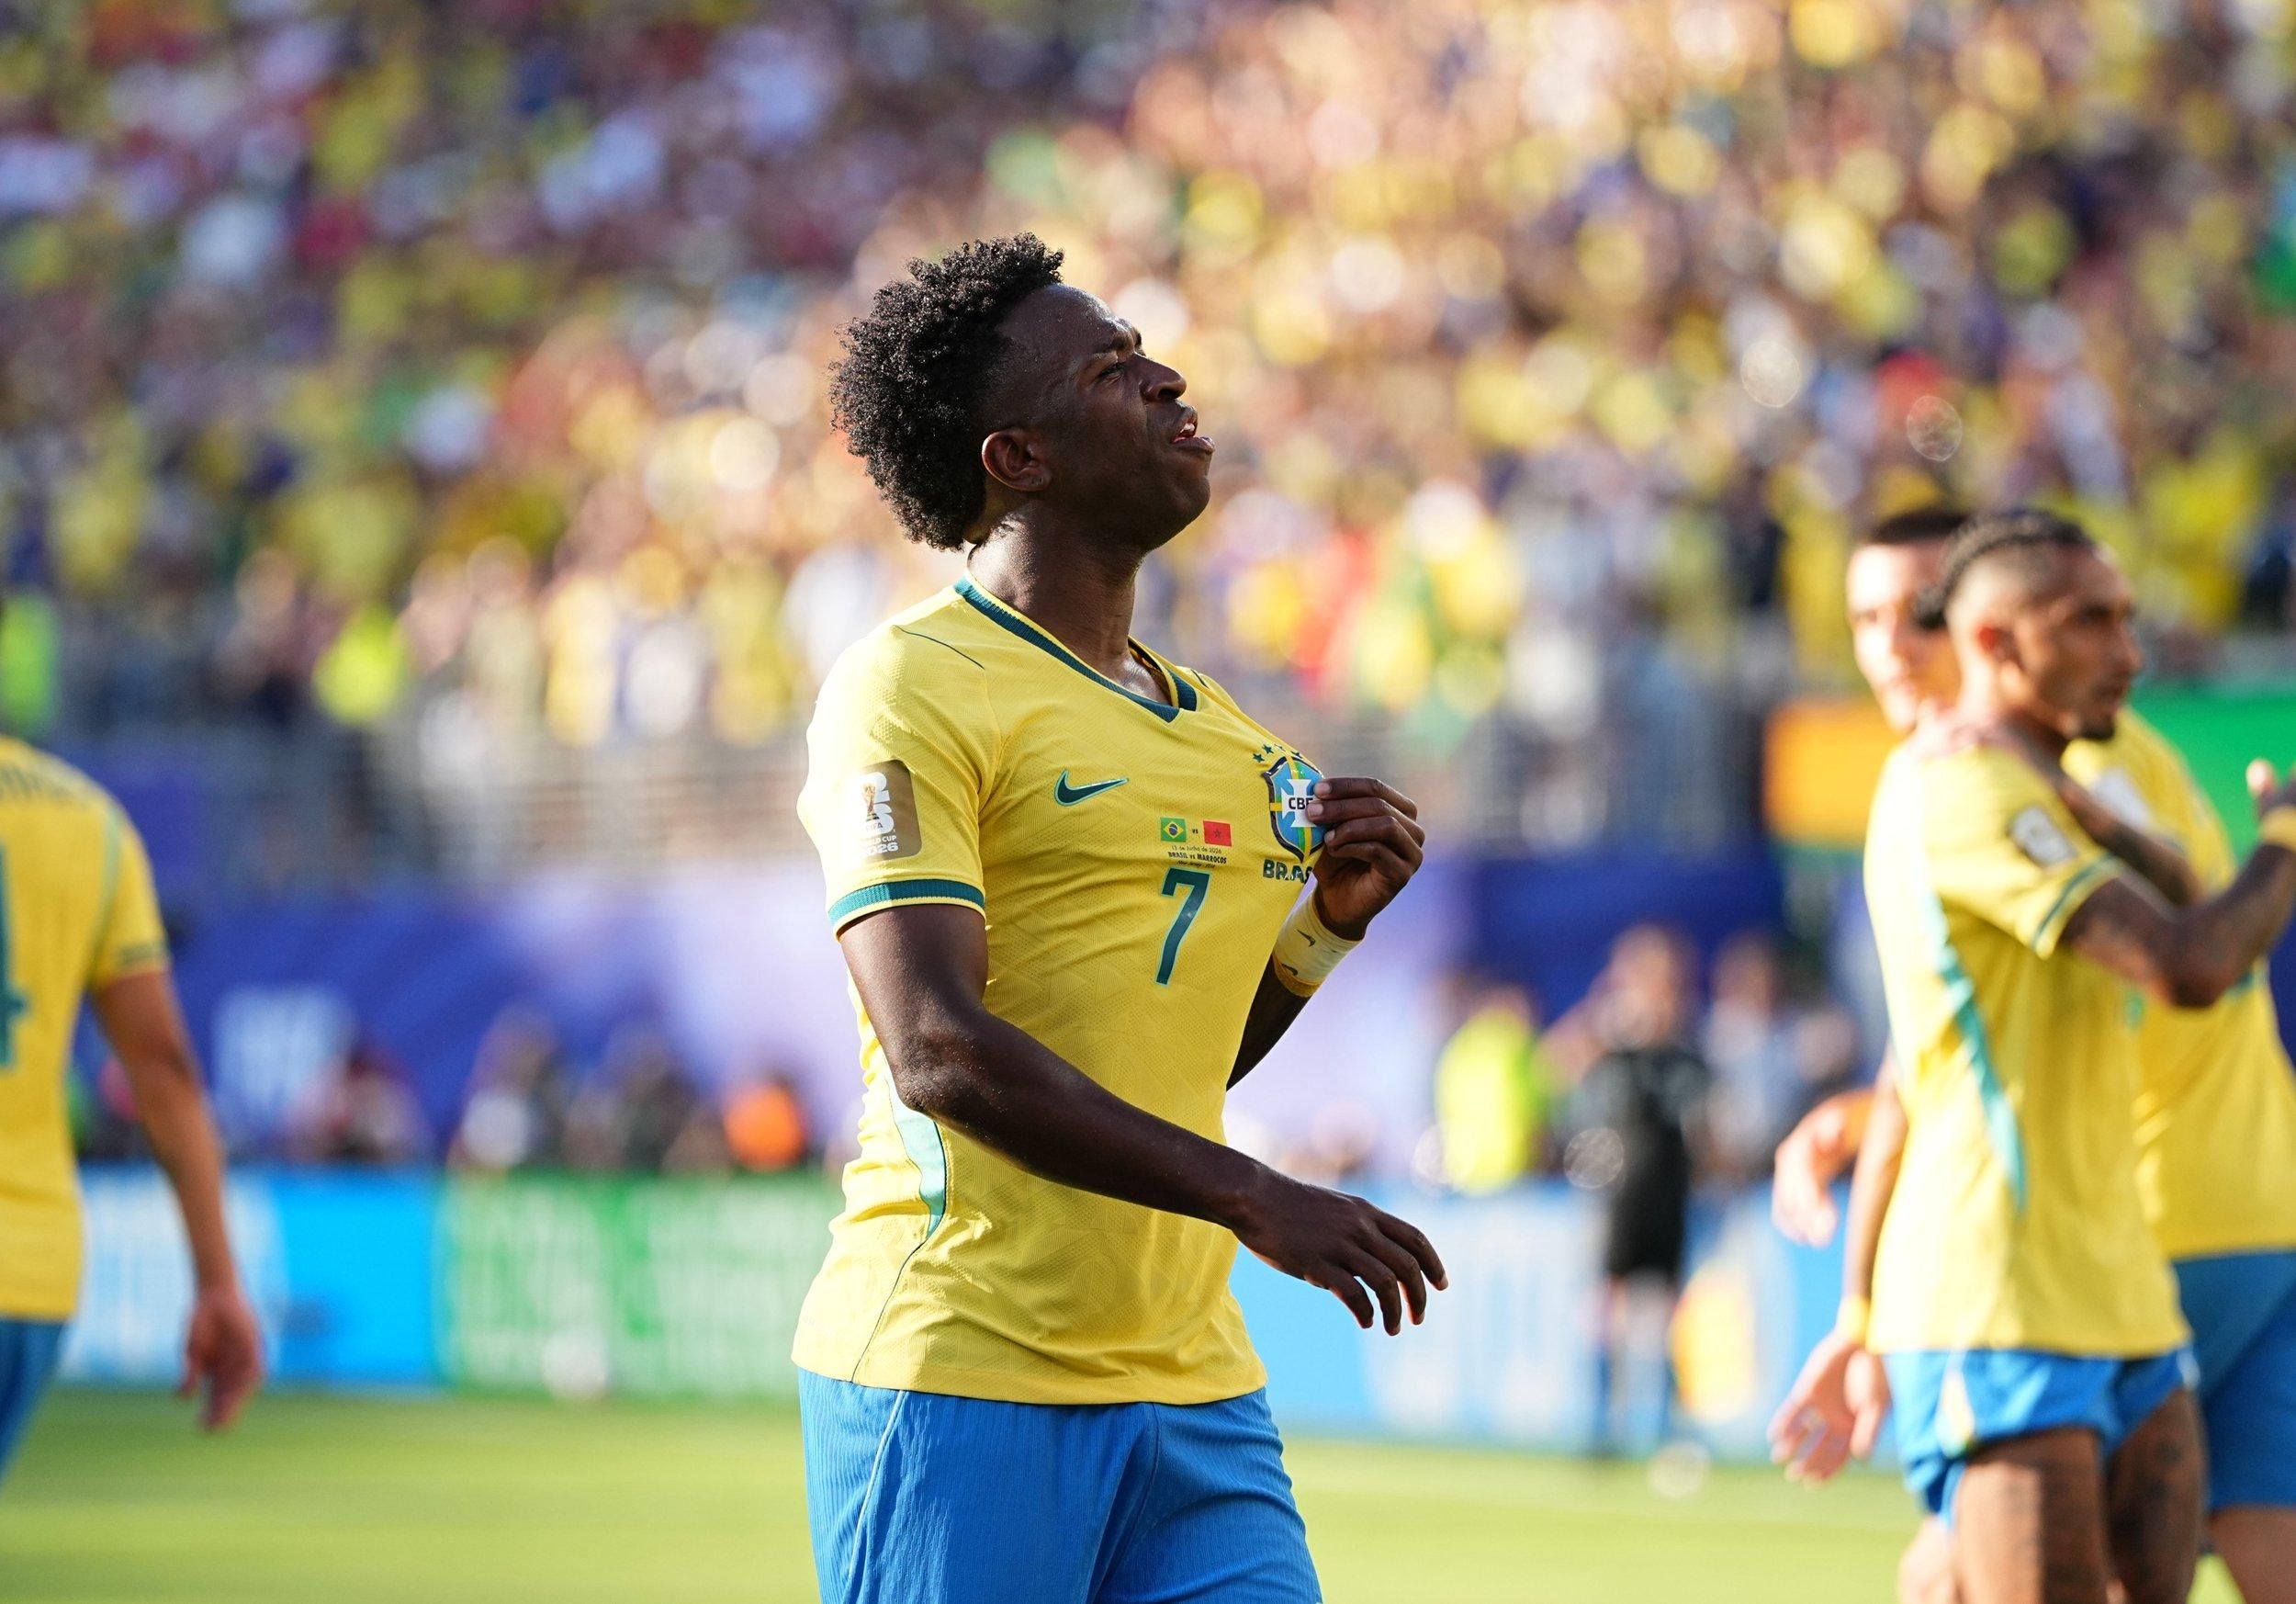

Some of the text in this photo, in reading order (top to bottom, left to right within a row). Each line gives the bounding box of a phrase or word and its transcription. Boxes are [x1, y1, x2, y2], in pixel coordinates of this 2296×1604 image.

[1167, 851, 1188, 859] BRASIL
[1197, 853, 1227, 864] MARROCOS
[1263, 858, 1312, 884] BRA
[1154, 866, 1211, 987] 7
